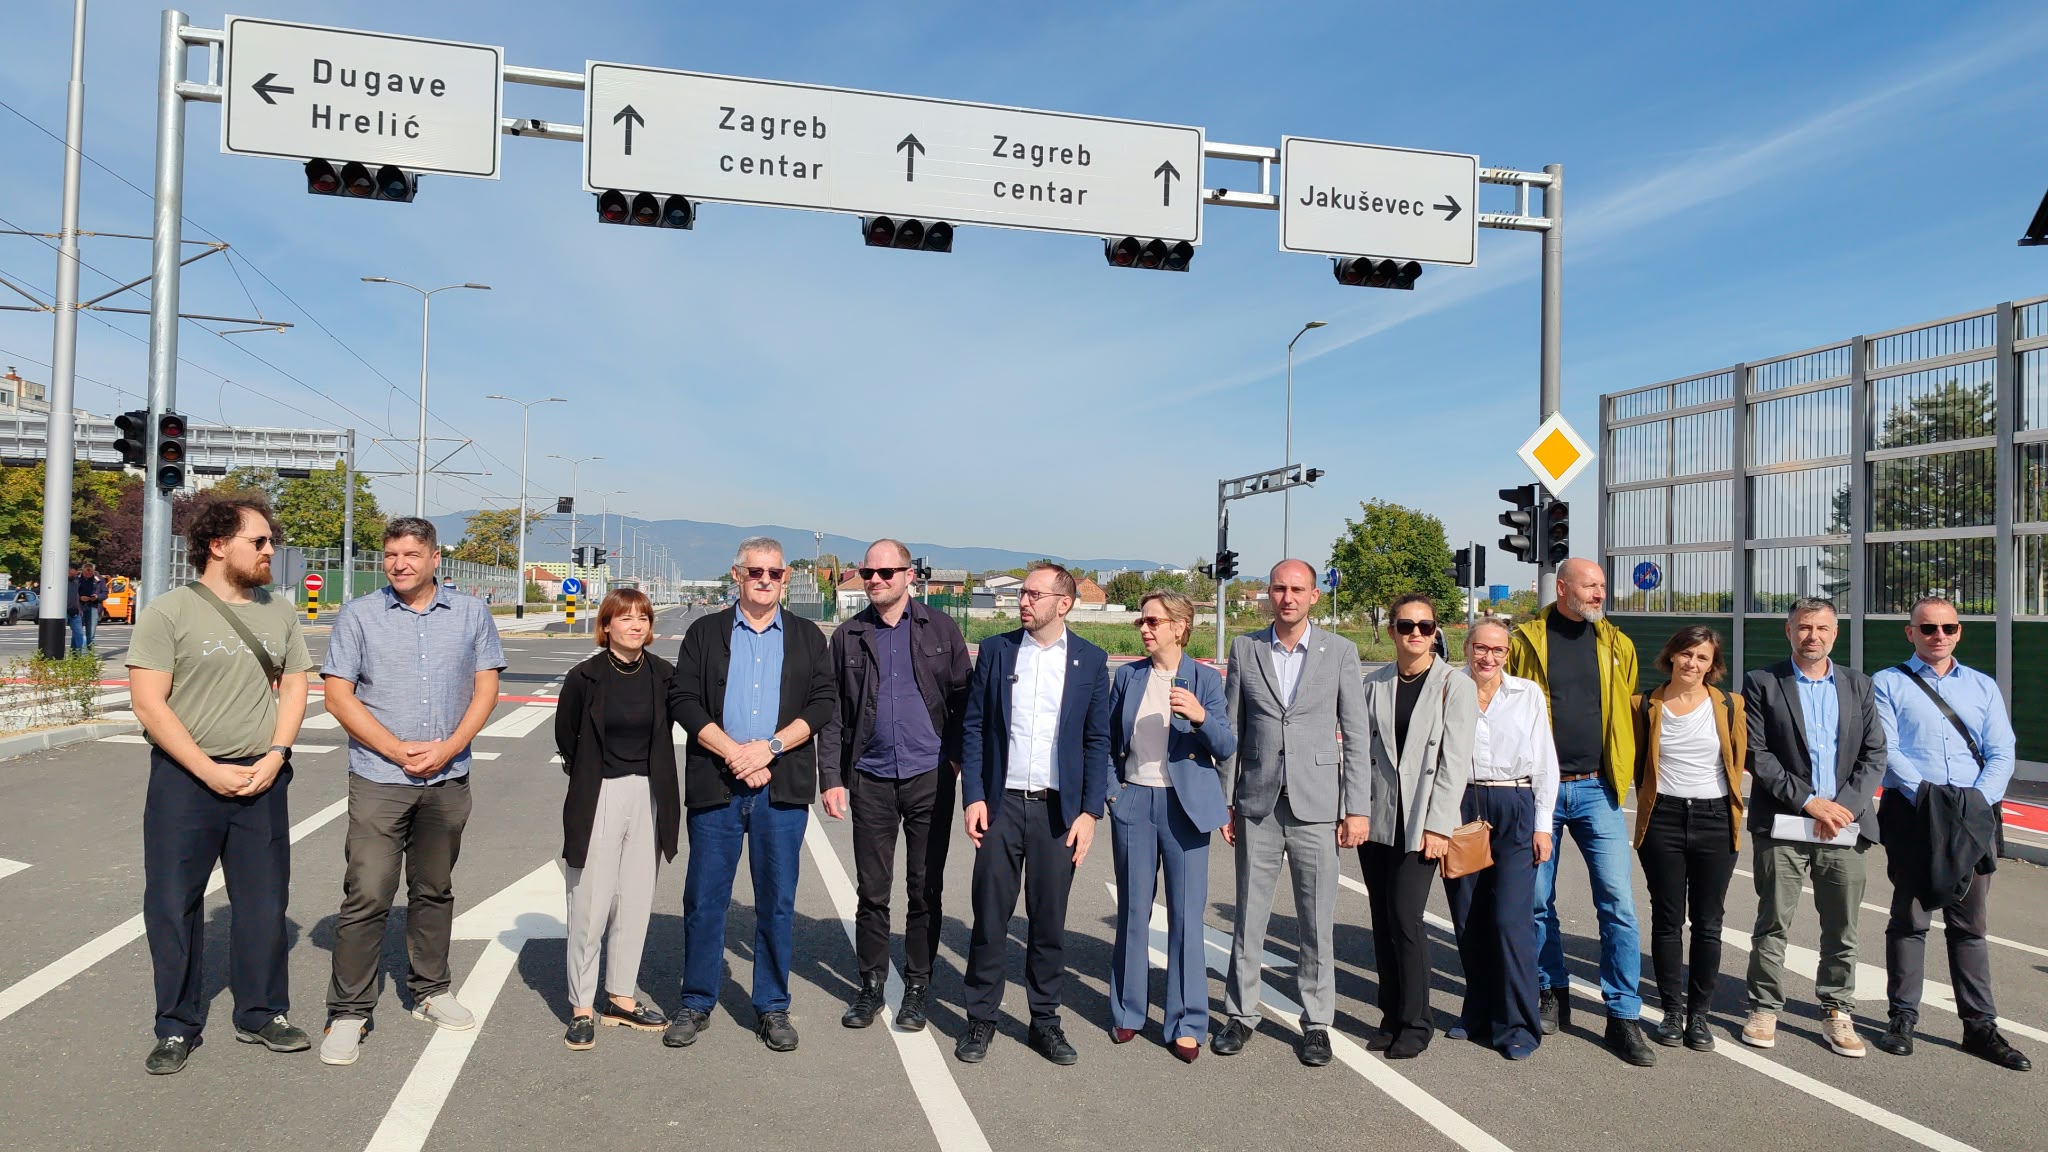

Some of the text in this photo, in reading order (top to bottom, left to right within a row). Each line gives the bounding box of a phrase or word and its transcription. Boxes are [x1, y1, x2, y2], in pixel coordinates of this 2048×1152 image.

[313, 58, 446, 97] Dugave
[311, 103, 420, 139] Hrelić
[718, 106, 826, 141] Zagreb
[720, 154, 823, 180] centar
[992, 134, 1091, 168] Zagreb
[993, 181, 1088, 206] centar
[1299, 185, 1424, 217] Jakuševec
